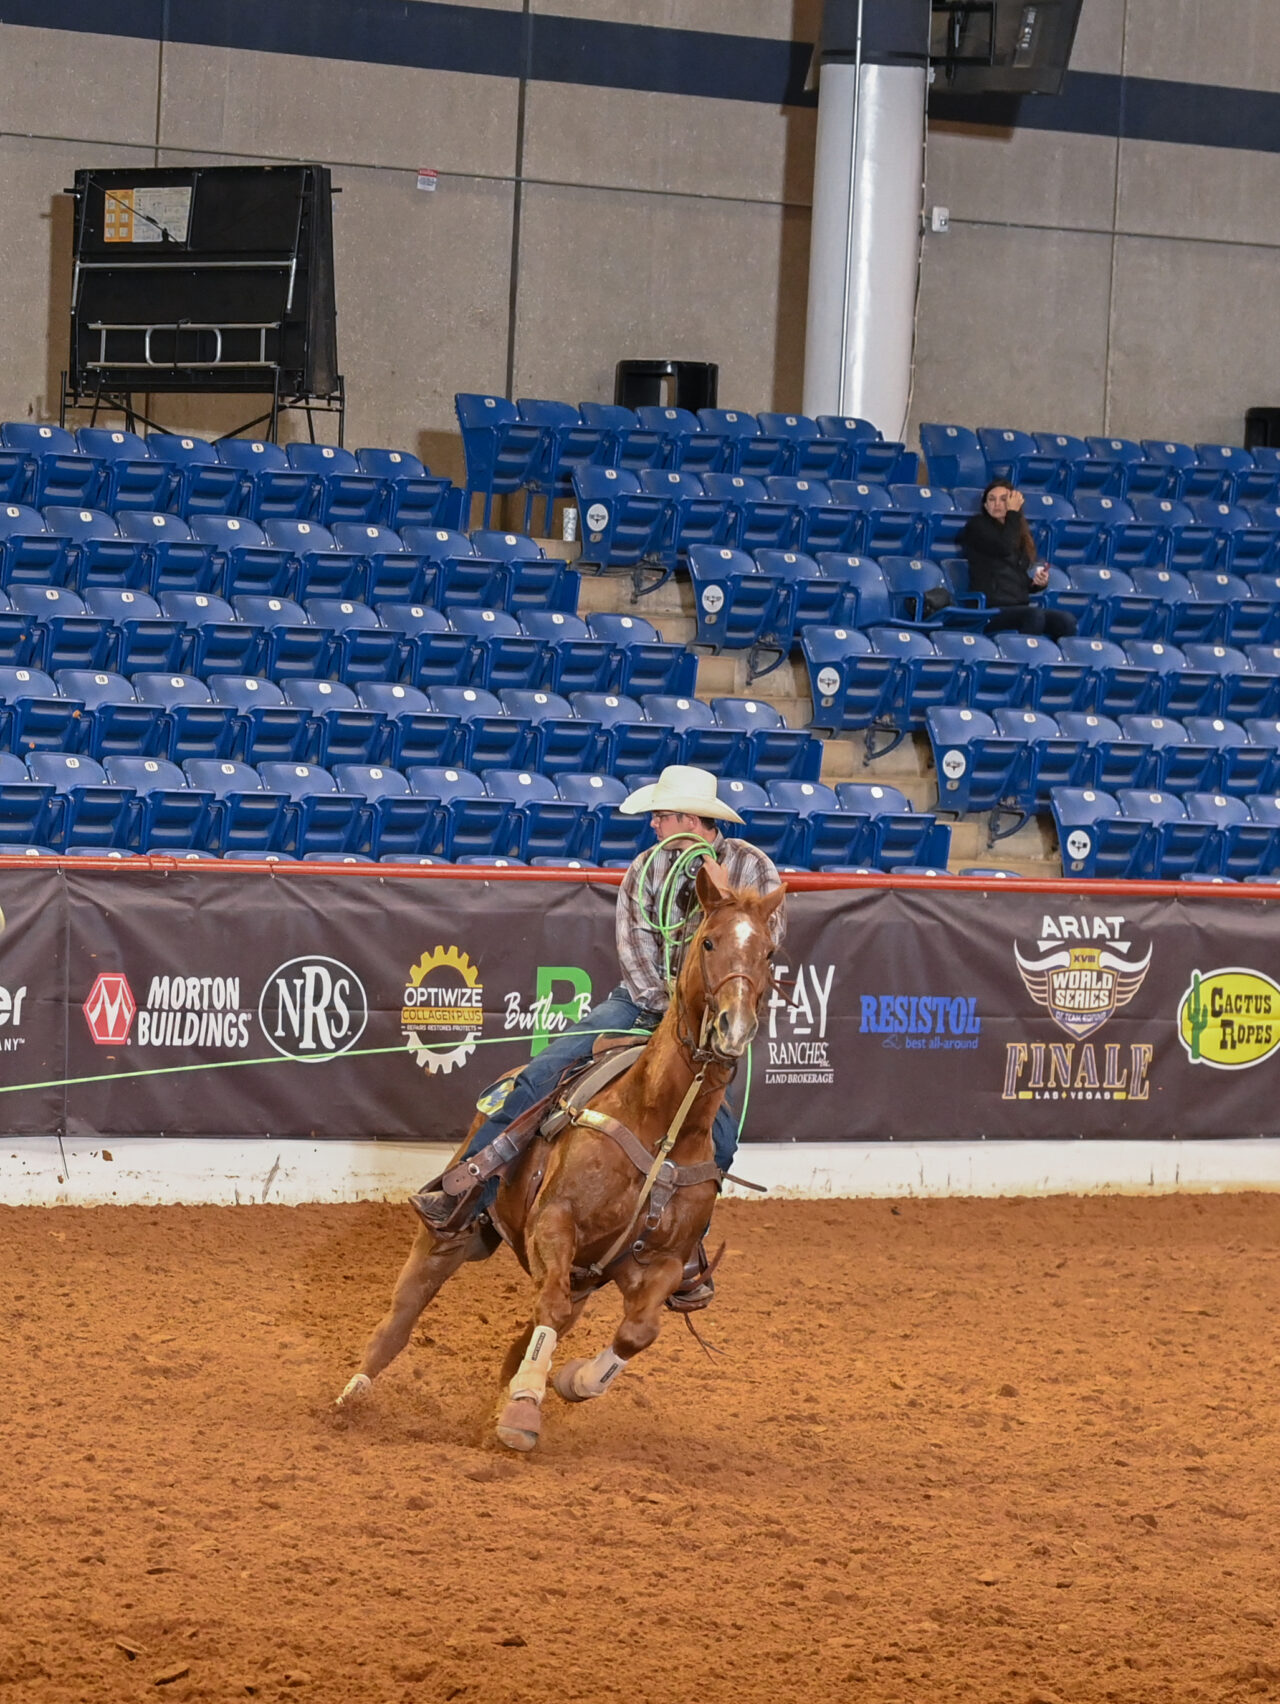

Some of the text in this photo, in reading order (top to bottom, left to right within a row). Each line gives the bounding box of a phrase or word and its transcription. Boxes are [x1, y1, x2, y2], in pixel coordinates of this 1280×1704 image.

[1042, 915, 1125, 939] ARIAT
[1052, 971, 1113, 989] WORLD
[147, 975, 239, 1010] MORTON
[404, 987, 483, 1007] OPTIWIZE
[1055, 989, 1110, 1009] SERIES
[274, 966, 350, 1049] NRS
[402, 1009, 482, 1021] COLLAGEN PLUS
[504, 991, 568, 1031] Butler
[859, 995, 980, 1035] RESISTOL
[768, 1042, 829, 1065] RANCHES
[906, 1037, 926, 1049] best
[765, 1073, 834, 1084] LAND BROKERAGE
[1002, 1043, 1153, 1100] FINALE
[1036, 1091, 1111, 1100] LAS VEGAS
